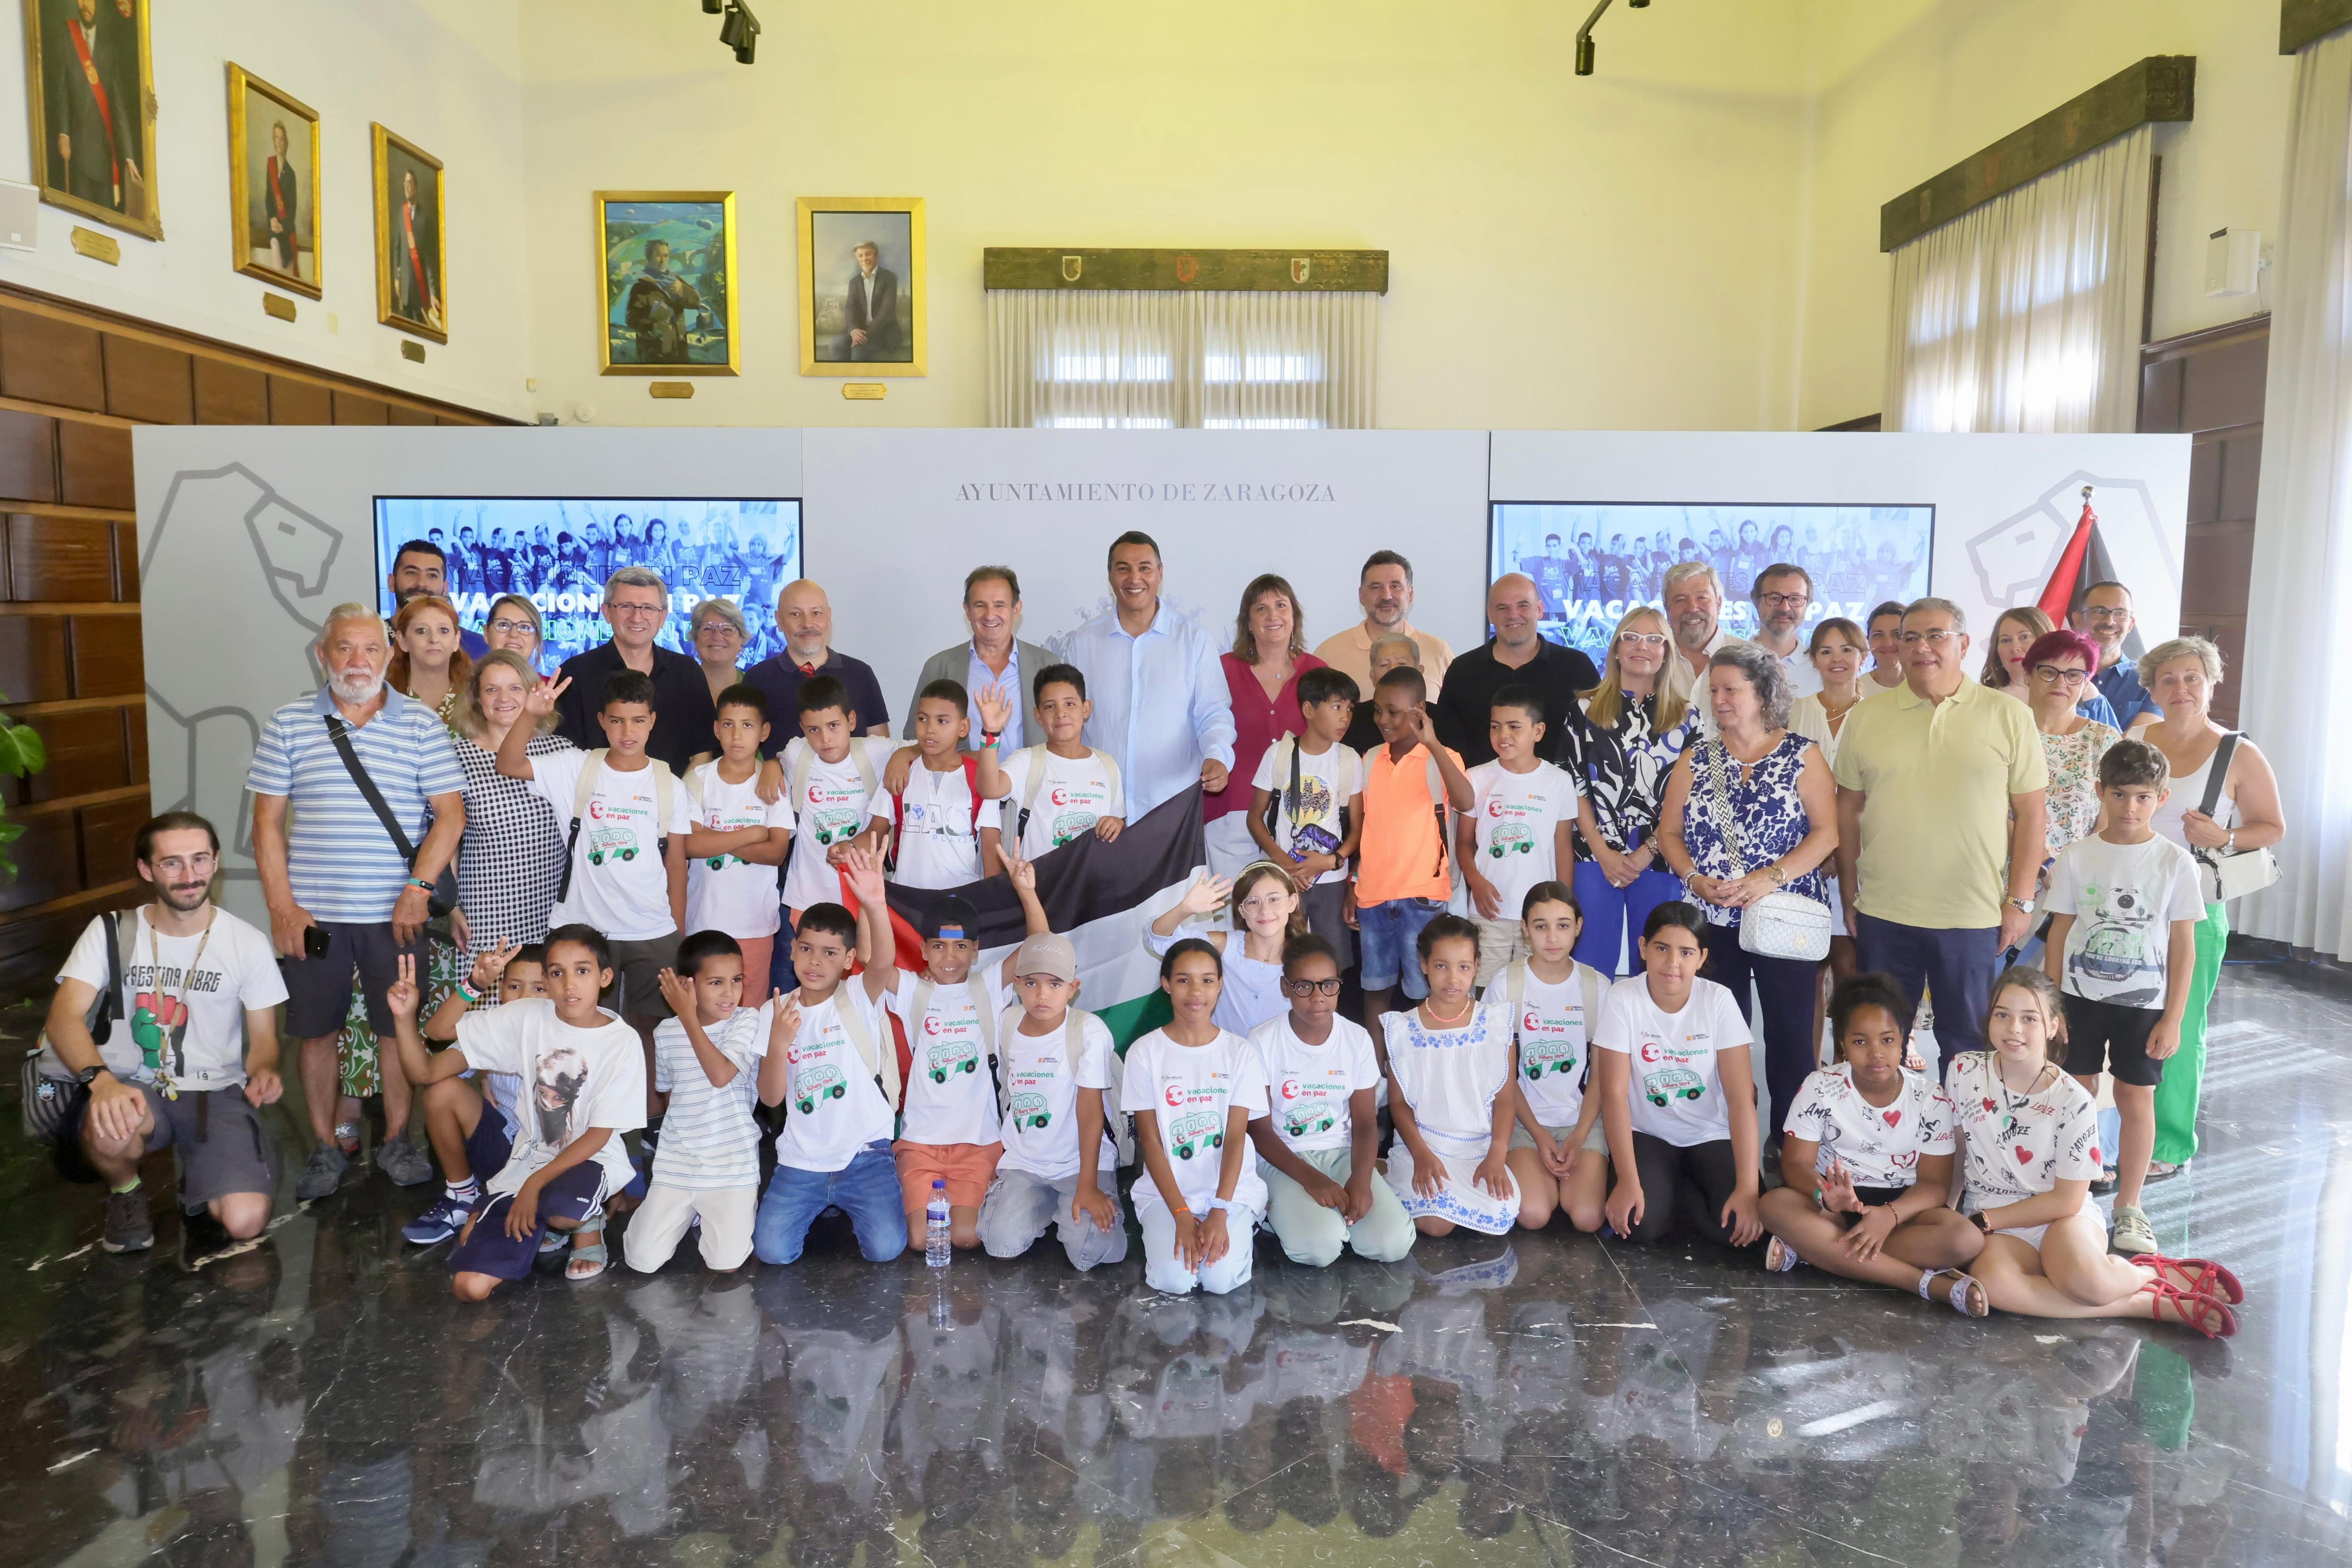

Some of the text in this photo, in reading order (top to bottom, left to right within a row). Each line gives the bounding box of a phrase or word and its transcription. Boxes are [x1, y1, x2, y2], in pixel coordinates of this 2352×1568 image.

[956, 483, 1336, 502] AYUNTAMIENTO DE ZARAGOZA
[447, 565, 622, 585] VACACIONE
[683, 566, 741, 586] PAZ
[1805, 602, 1865, 621] PAZ
[608, 807, 648, 816] vacaciones
[1506, 804, 1542, 813] vacaciones
[2085, 952, 2104, 960] YOU'RE
[2104, 956, 2130, 965] LOOKING
[802, 1039, 845, 1052] vacaciones
[1837, 1092, 1850, 1101] LOVE
[2029, 1101, 2056, 1117] LOVE
[1973, 1115, 1987, 1123] LOVE
[1996, 1126, 2031, 1150] J'ADORE
[2069, 1123, 2096, 1162] J'ADORE
